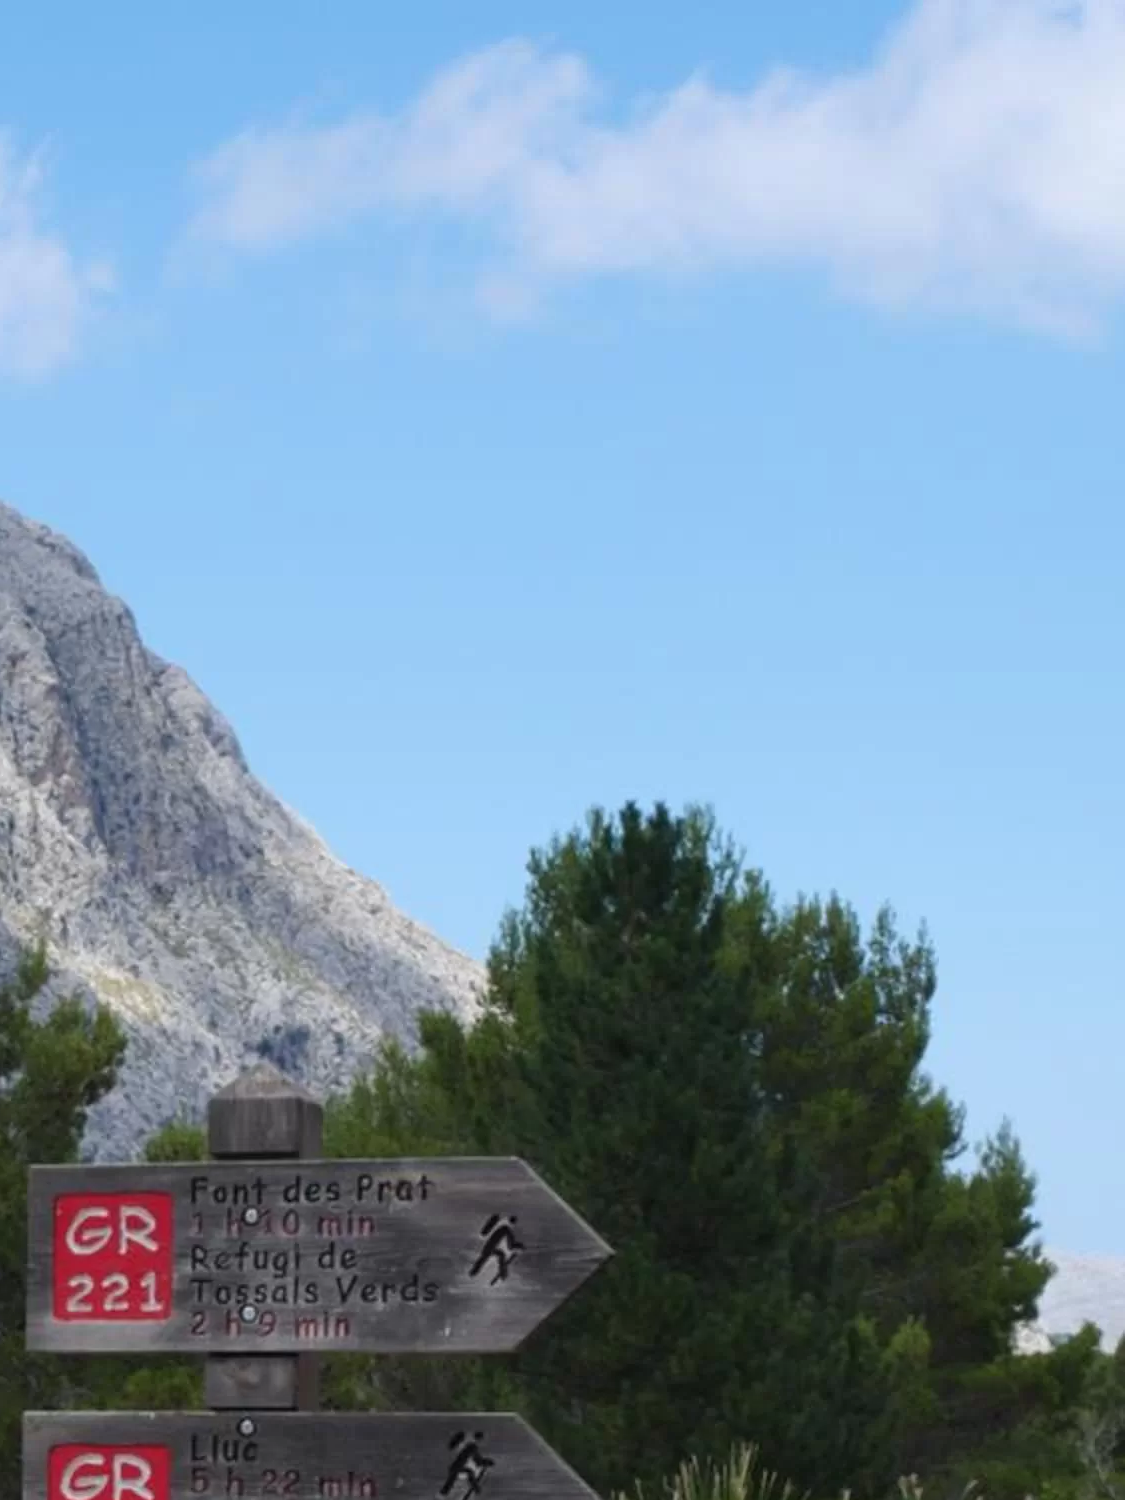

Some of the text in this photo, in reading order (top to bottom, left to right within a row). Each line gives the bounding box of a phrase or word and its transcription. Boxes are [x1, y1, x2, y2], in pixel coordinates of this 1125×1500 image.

[190, 1173, 436, 1204] Font des Prat
[65, 1204, 159, 1256] GR
[191, 1210, 204, 1236] 1
[226, 1208, 244, 1237] h
[316, 1210, 376, 1238] min
[190, 1241, 358, 1278] Refugi de
[65, 1271, 164, 1313] 221
[190, 1274, 440, 1305] Tossals Verds
[190, 1310, 207, 1337] 2
[225, 1310, 242, 1338] h
[294, 1310, 352, 1338] min
[190, 1434, 259, 1464] Lluc
[190, 1466, 377, 1498] 5 h 22 min
